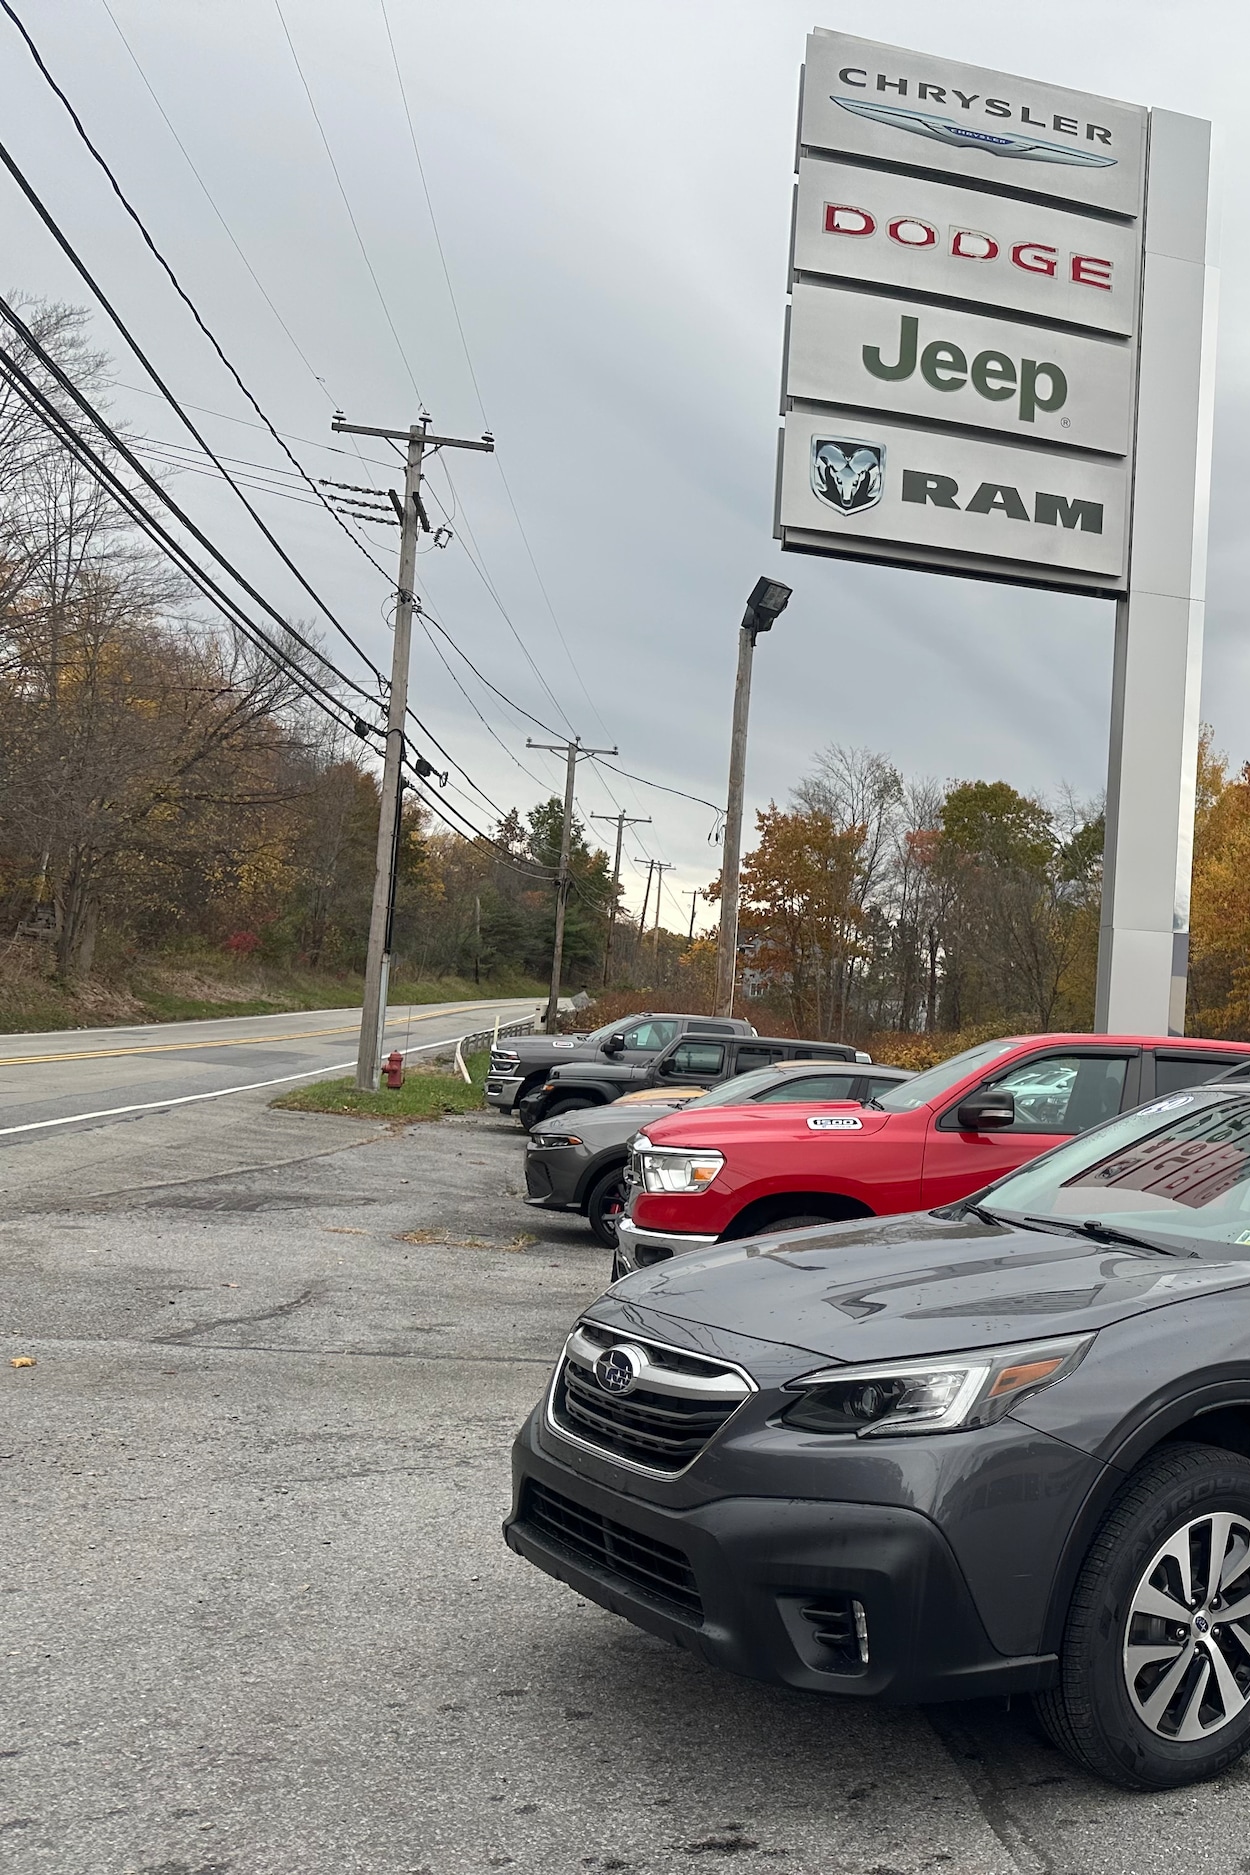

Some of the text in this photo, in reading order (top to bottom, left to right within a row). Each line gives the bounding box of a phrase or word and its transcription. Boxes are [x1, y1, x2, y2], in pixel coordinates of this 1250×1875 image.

[838, 67, 1113, 146] CHRYSLER
[950, 128, 1006, 144] CHRYSLER
[824, 201, 1113, 291] DODGE
[862, 315, 1068, 422] Jeep
[901, 468, 1104, 535] RAM
